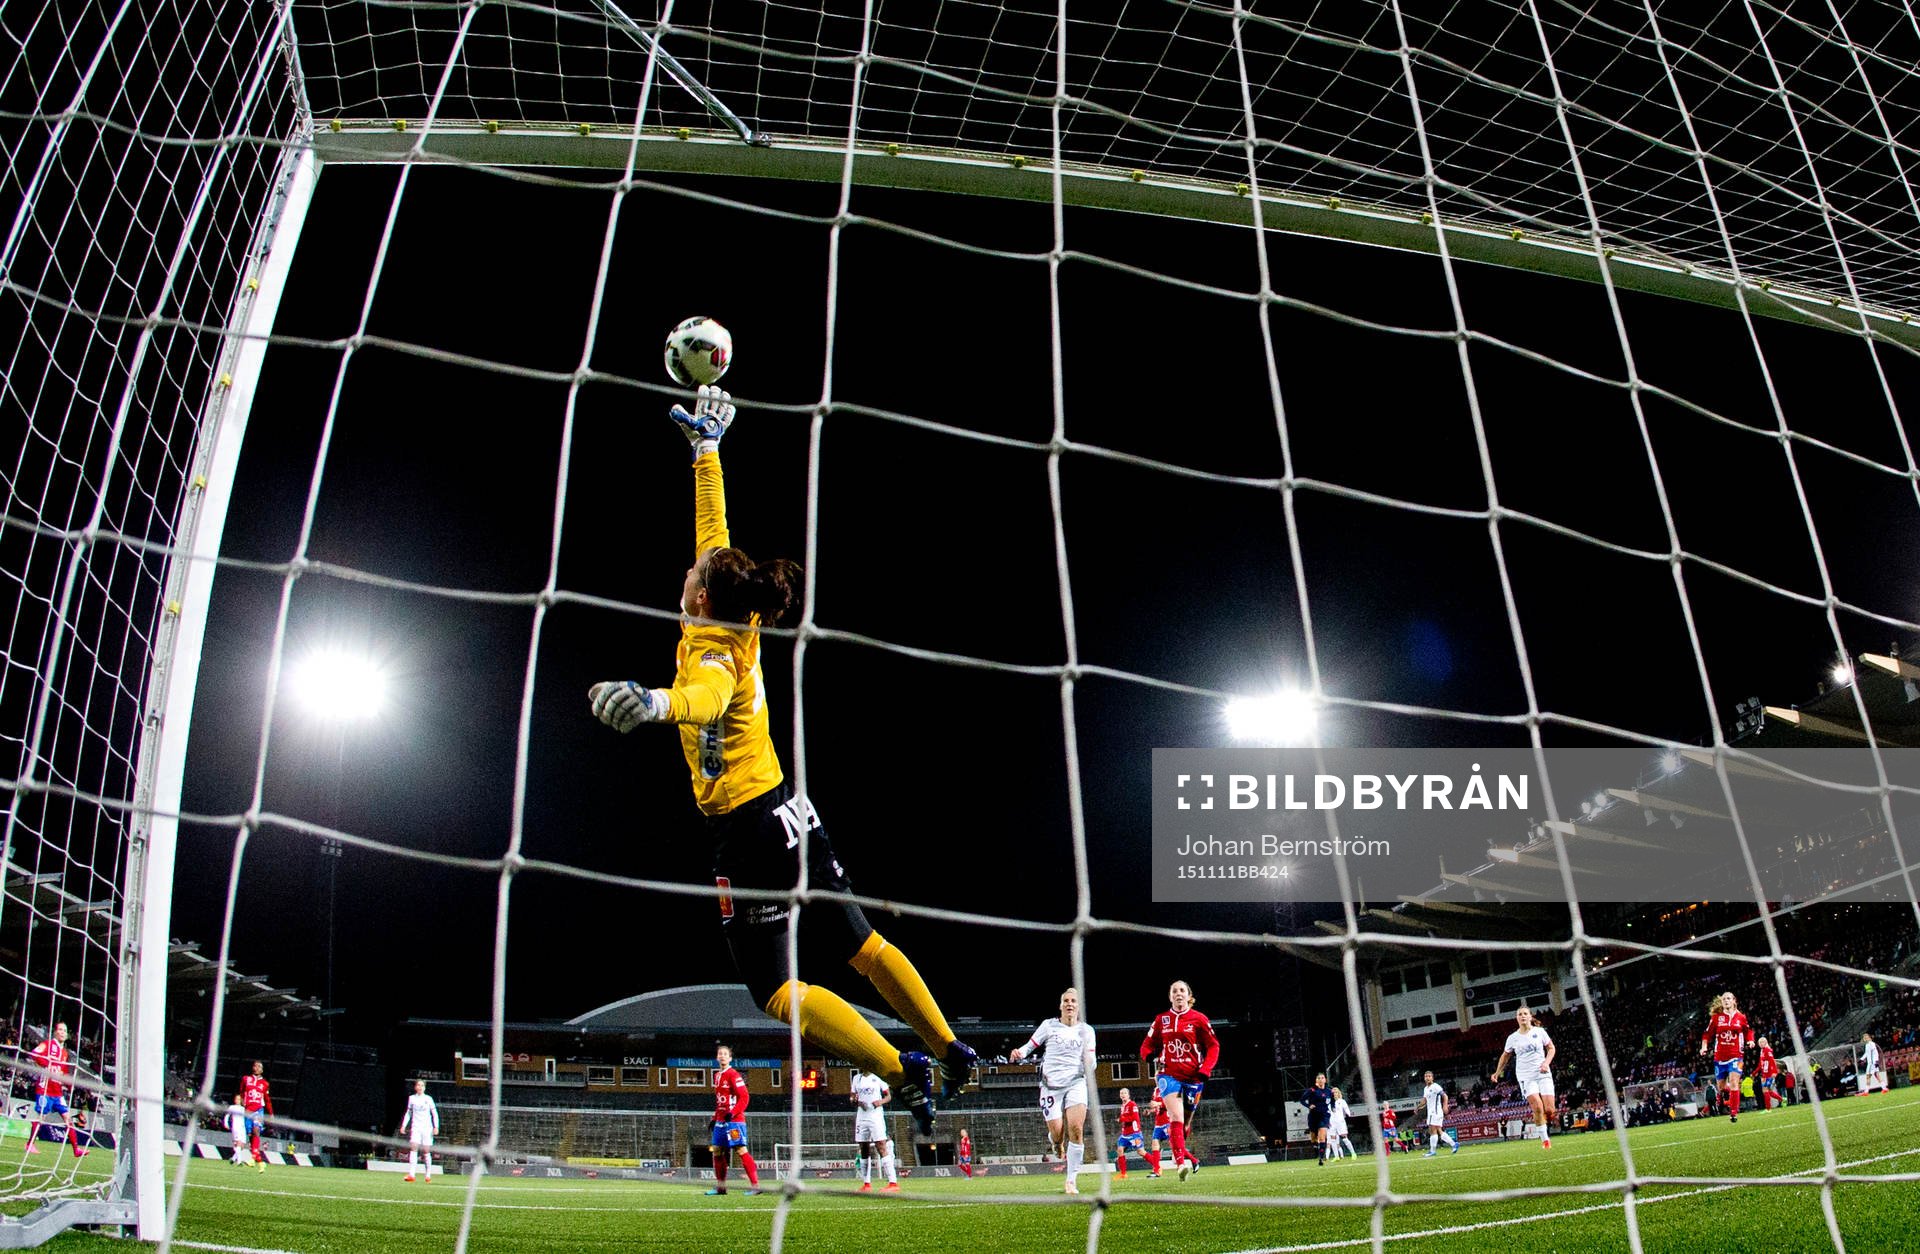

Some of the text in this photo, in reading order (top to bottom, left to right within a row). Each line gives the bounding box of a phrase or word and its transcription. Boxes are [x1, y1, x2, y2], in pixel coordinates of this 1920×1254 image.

[1167, 1038, 1192, 1058] ÖBO
[623, 1056, 654, 1065] EXACT
[1041, 1096, 1055, 1109] 29
[546, 1168, 562, 1177] NA
[935, 1168, 951, 1177] NA
[1011, 1166, 1028, 1175] NA
